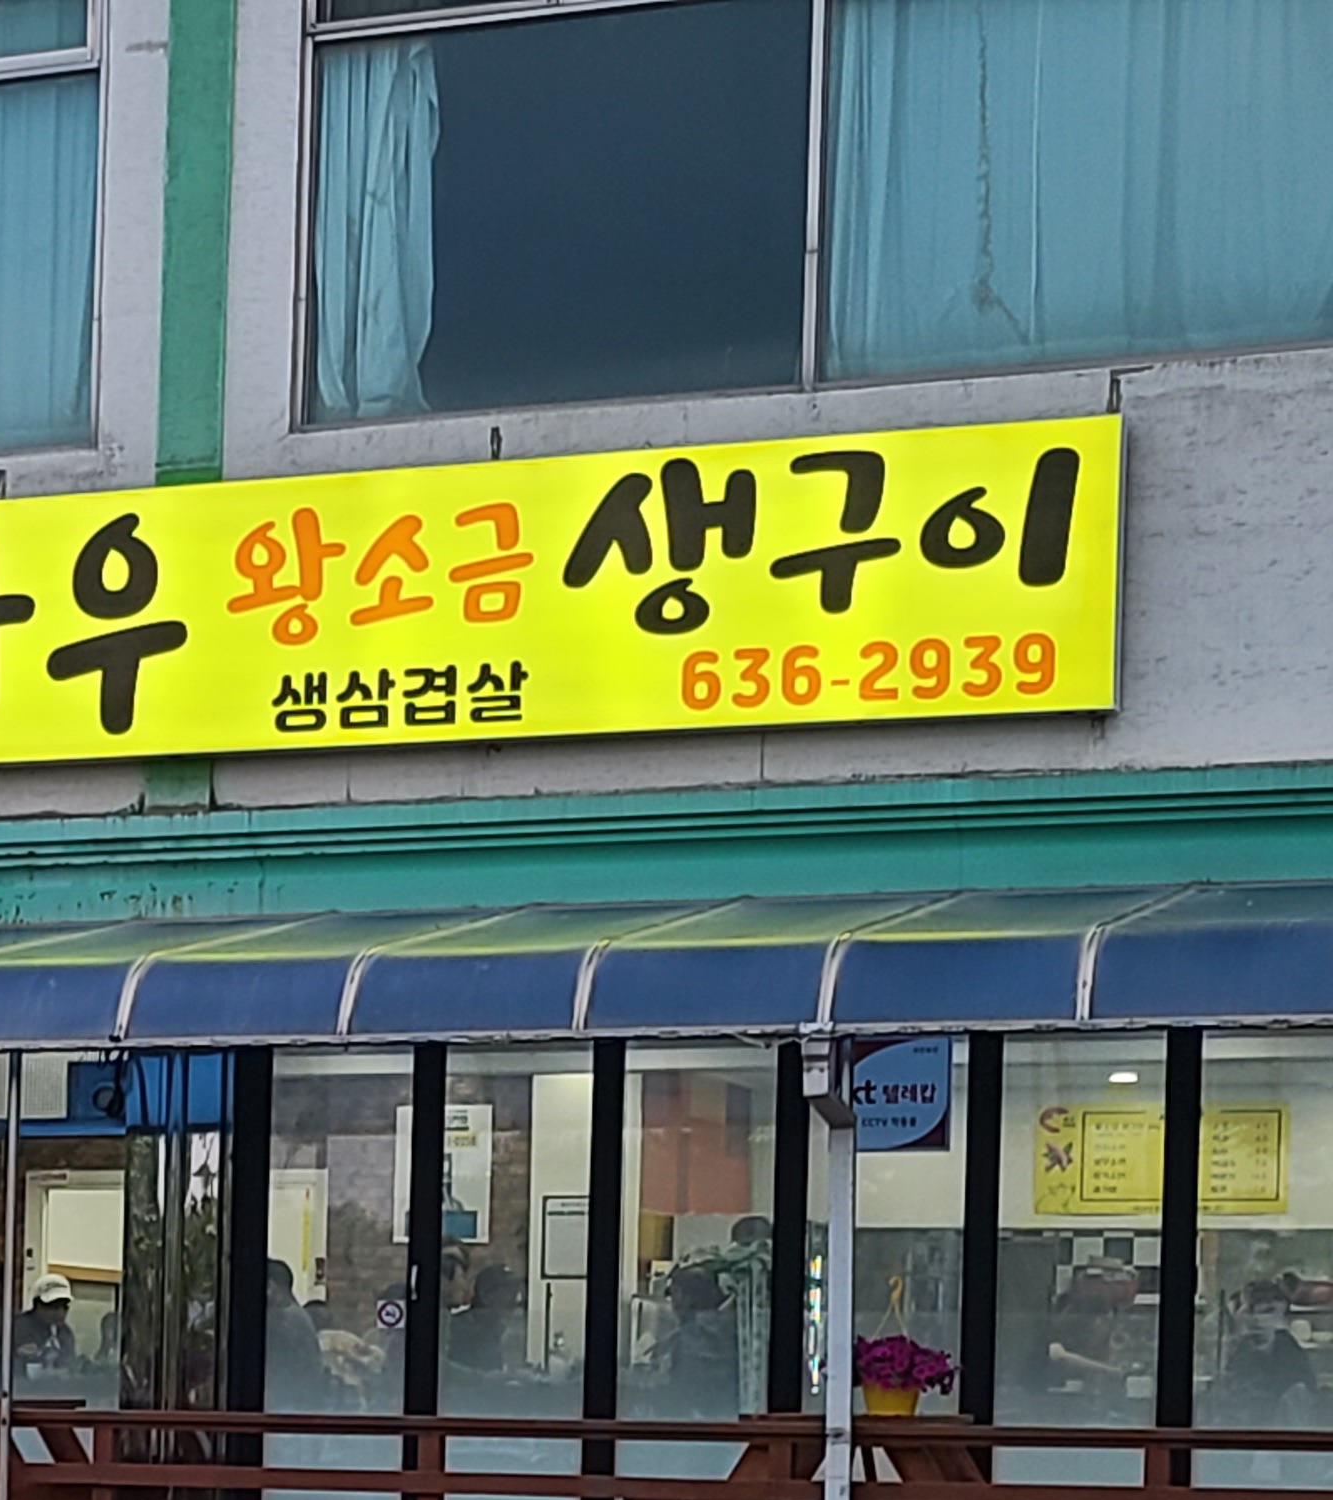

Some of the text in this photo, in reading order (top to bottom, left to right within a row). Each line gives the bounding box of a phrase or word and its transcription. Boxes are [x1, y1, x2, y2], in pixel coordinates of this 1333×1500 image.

[226, 502, 535, 646] 왕소금
[562, 446, 1081, 636] 생구이
[271, 659, 530, 733] 생삼겹살
[680, 632, 1058, 711] 636-2939
